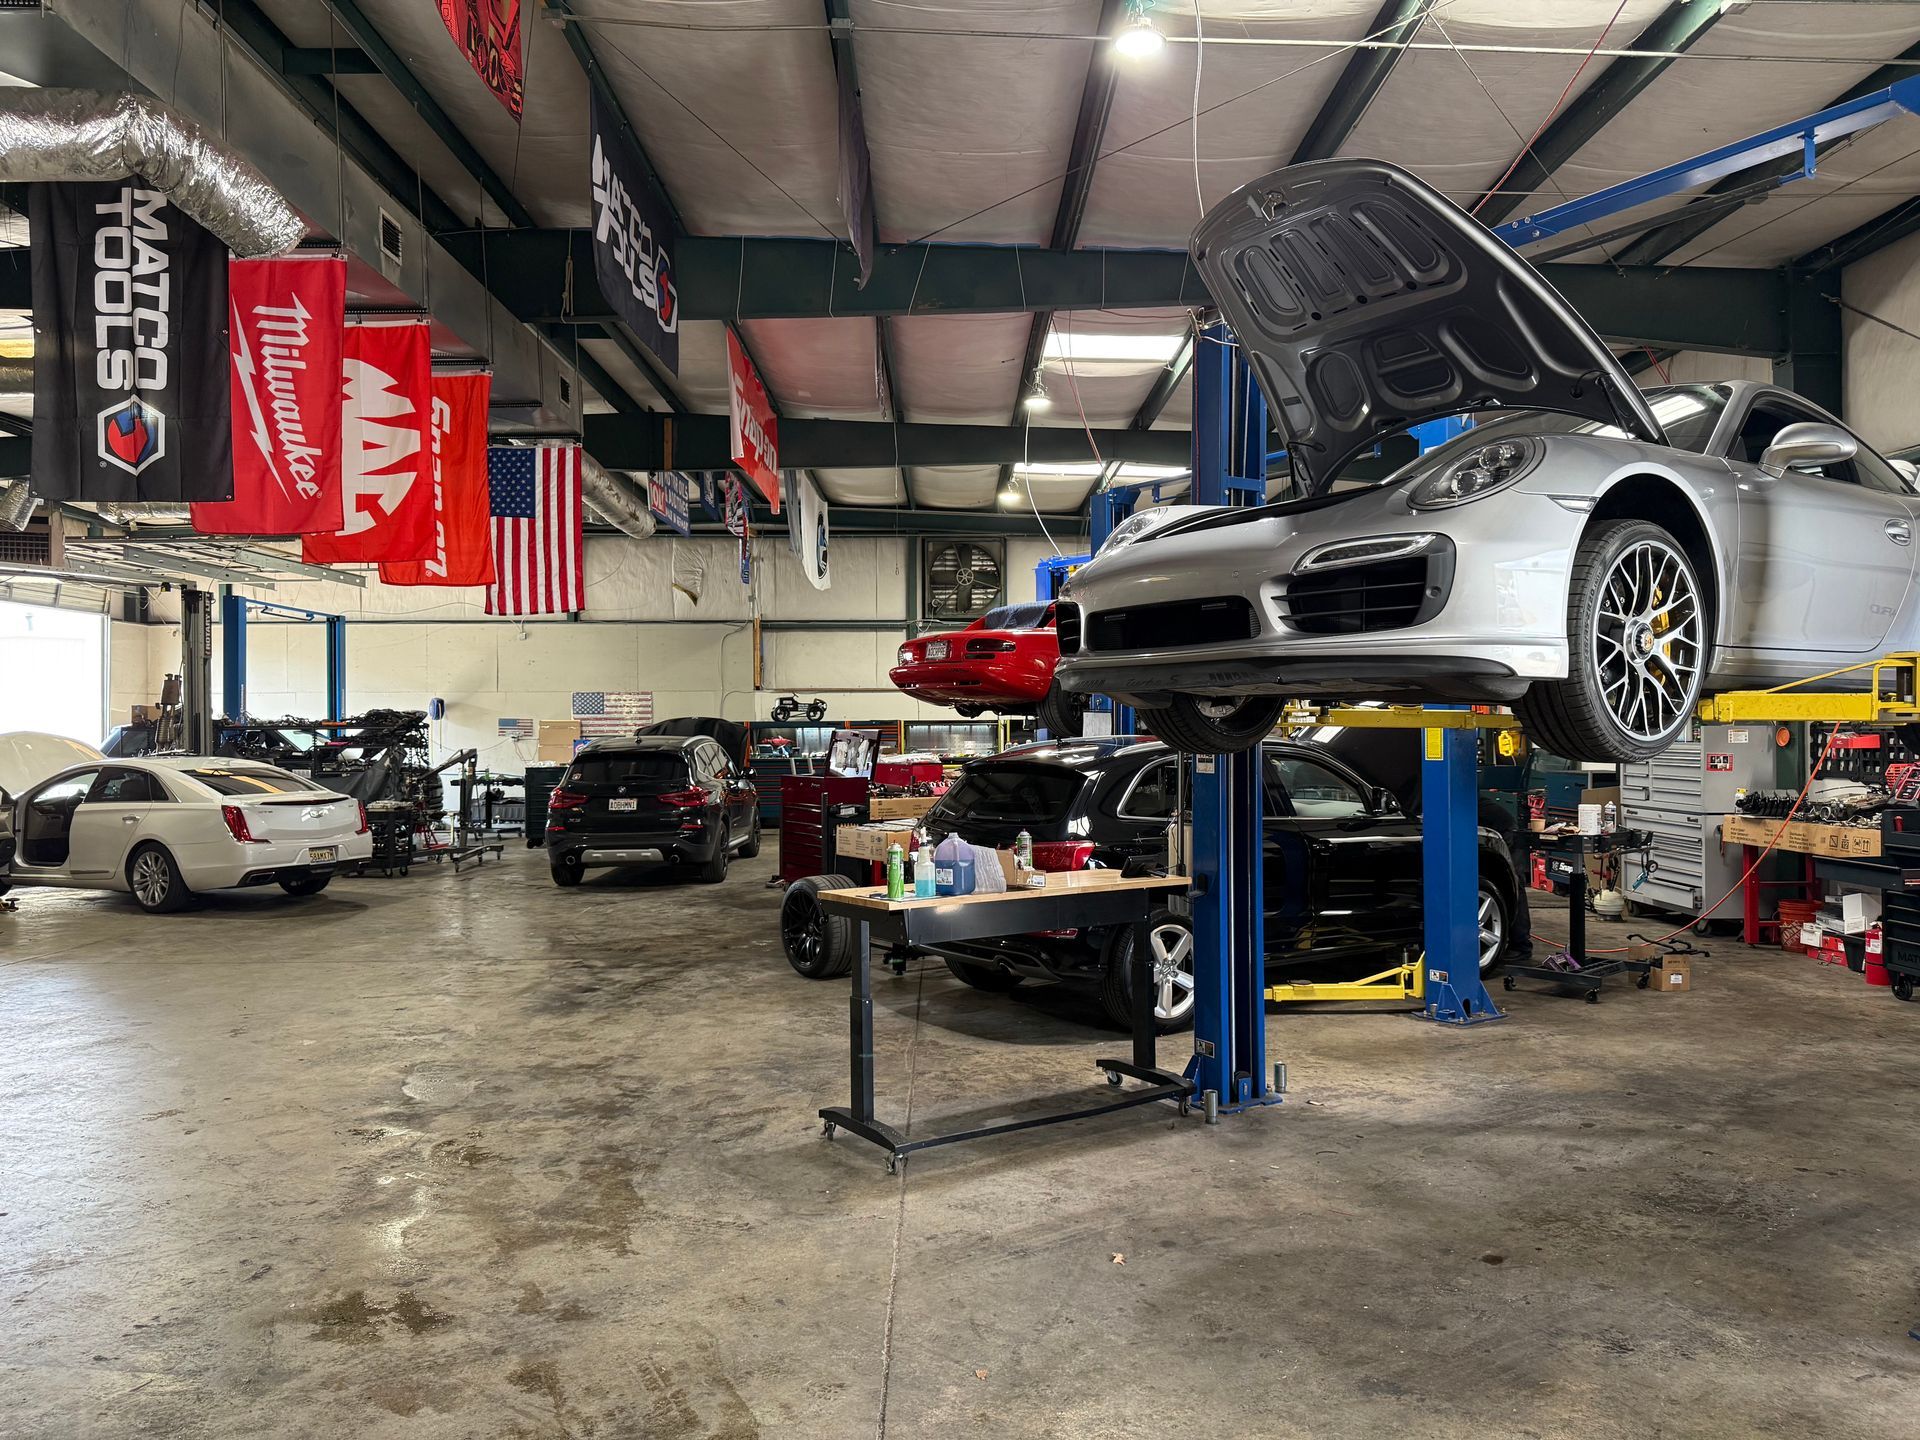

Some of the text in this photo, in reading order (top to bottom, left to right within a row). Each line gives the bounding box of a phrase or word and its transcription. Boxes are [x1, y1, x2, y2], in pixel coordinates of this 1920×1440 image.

[95, 187, 133, 390] TOOLS
[132, 188, 169, 390] MATCO
[252, 292, 323, 500] Milwaukee
[335, 358, 421, 537] MAC
[1897, 951, 1920, 964] MAT
